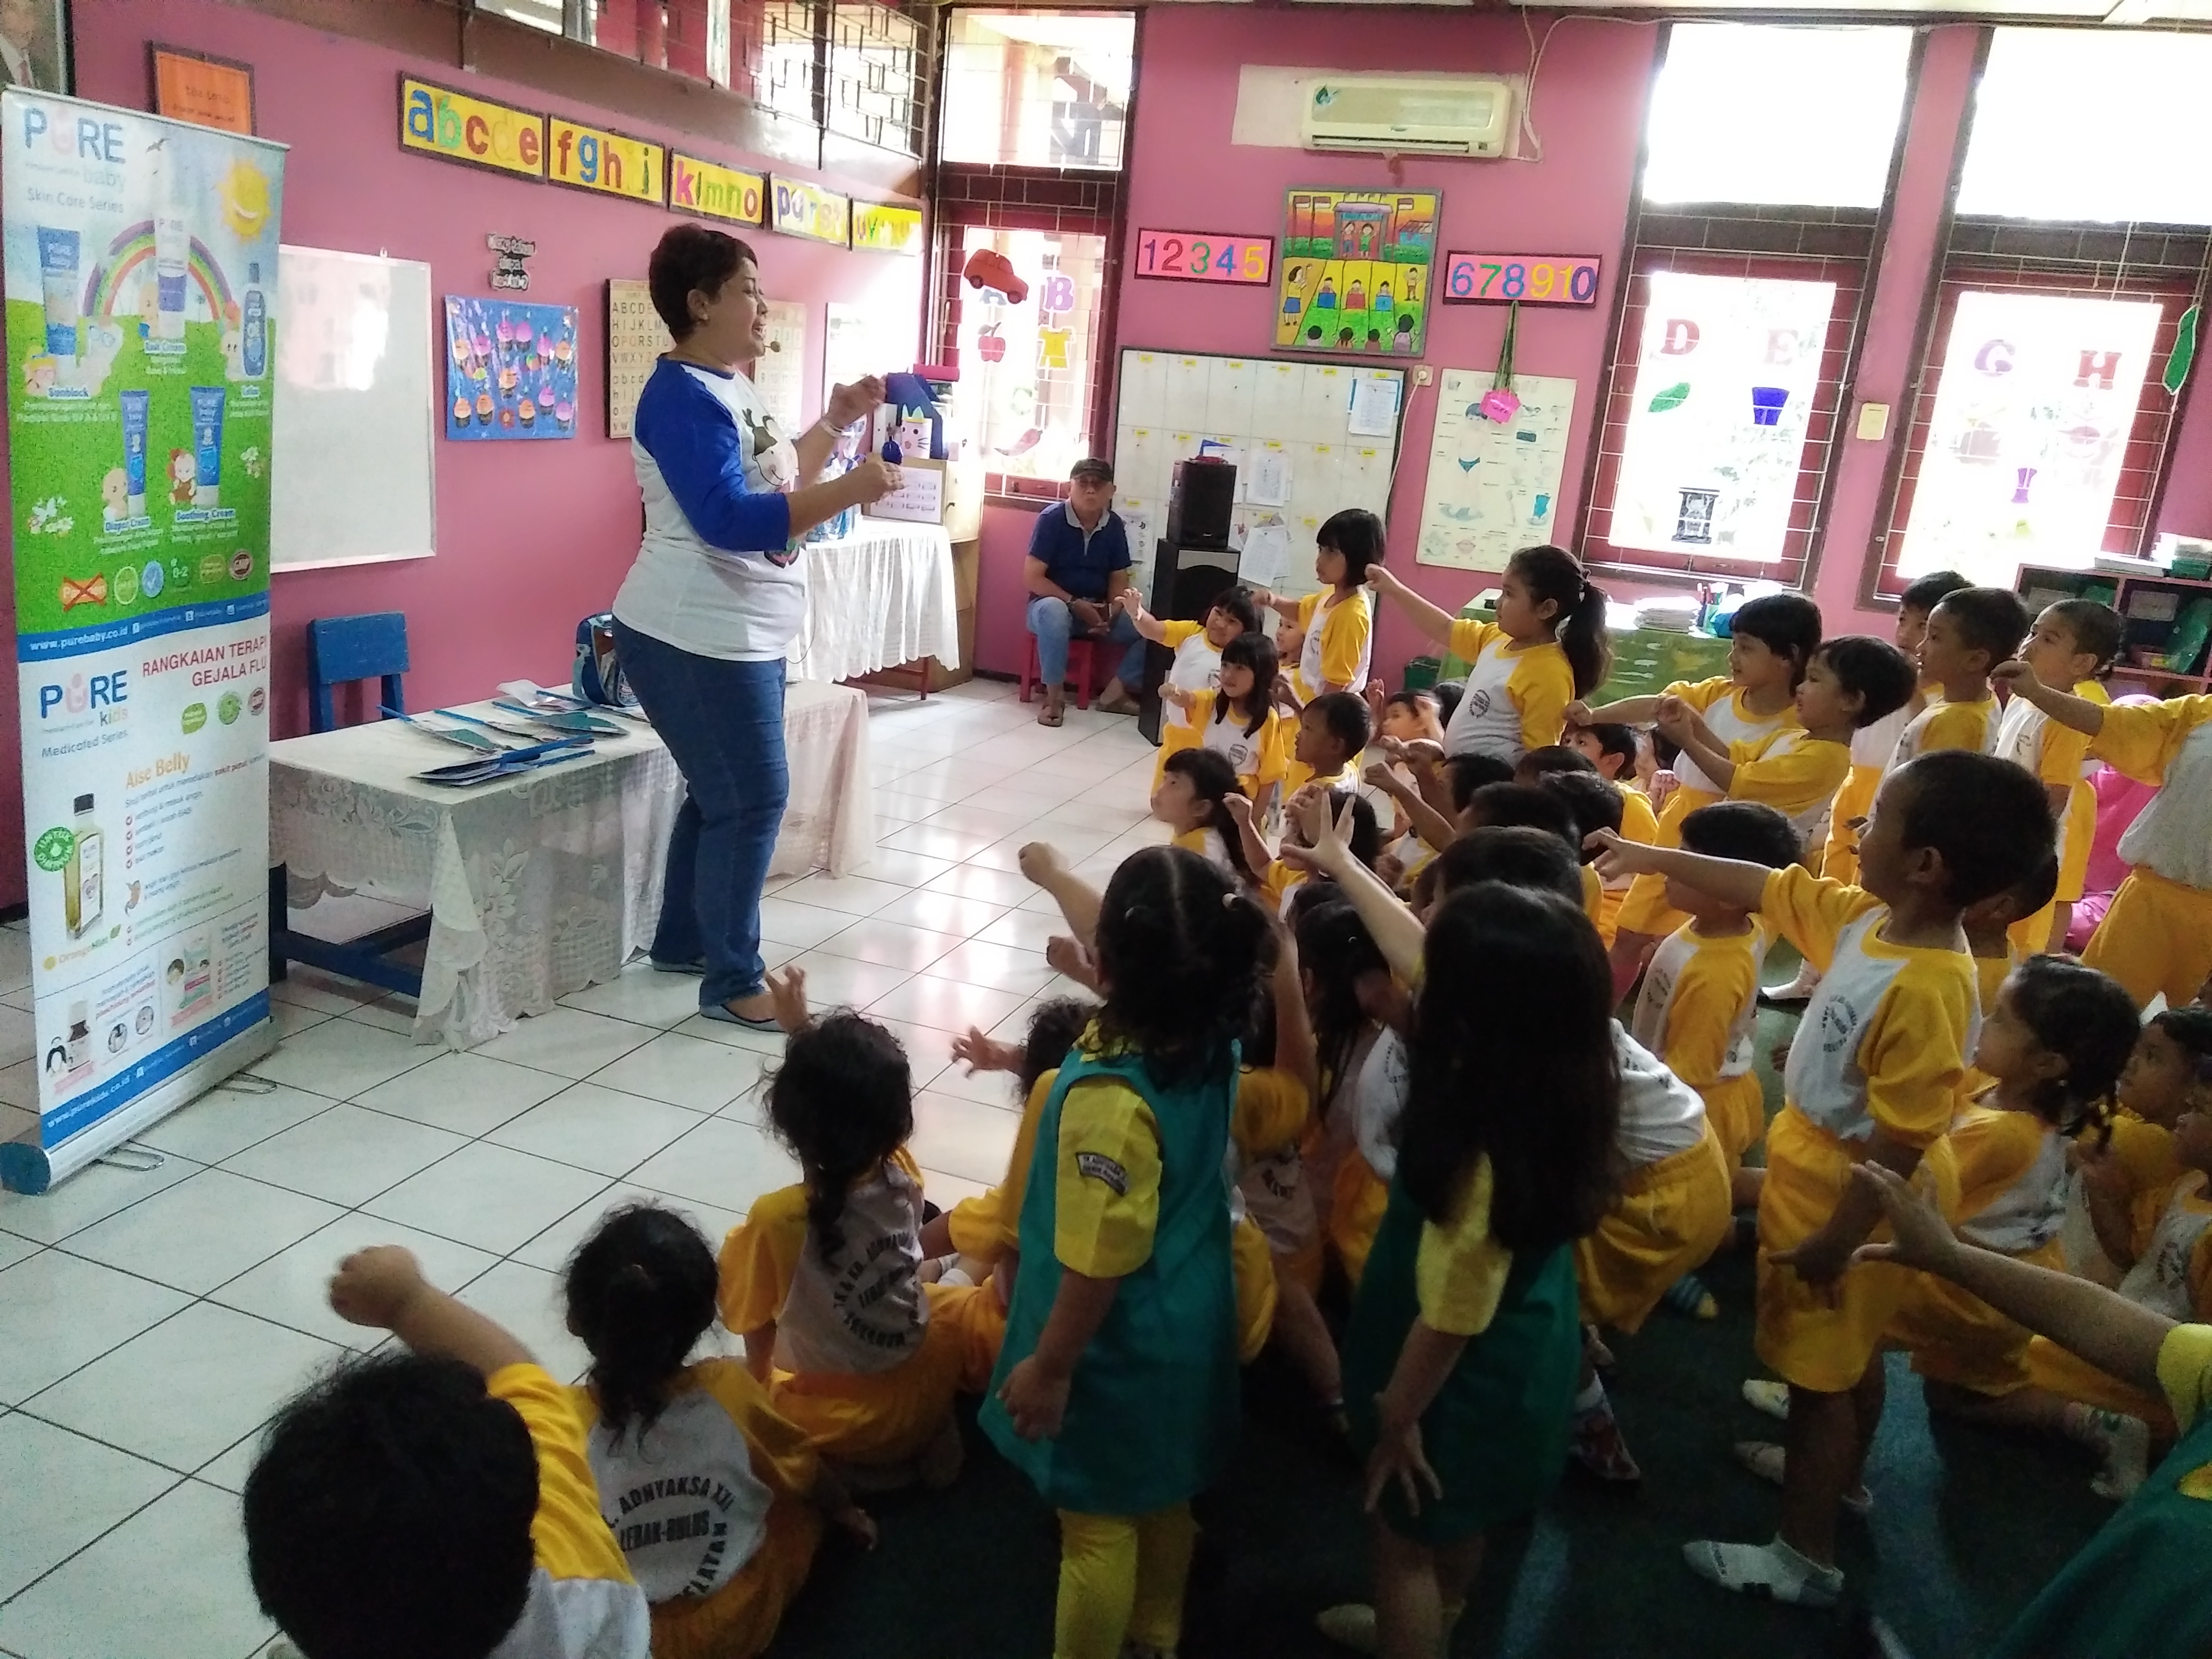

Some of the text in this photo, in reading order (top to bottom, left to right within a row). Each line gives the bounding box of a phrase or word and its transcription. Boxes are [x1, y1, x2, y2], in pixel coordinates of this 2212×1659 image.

[24, 106, 126, 164] PURE
[27, 187, 124, 213] Skin Care Series
[1045, 276, 1075, 312] B
[1660, 318, 2122, 390] D E G H
[48, 387, 89, 398] Sunblock
[29, 625, 128, 651] www.purebaby.co.id
[141, 645, 225, 677] RANGKAIAN
[191, 662, 246, 687] GEJALA
[40, 669, 128, 719] PURE
[98, 707, 129, 727] kids
[41, 729, 129, 758] Medicated Series
[155, 751, 191, 777] Belly
